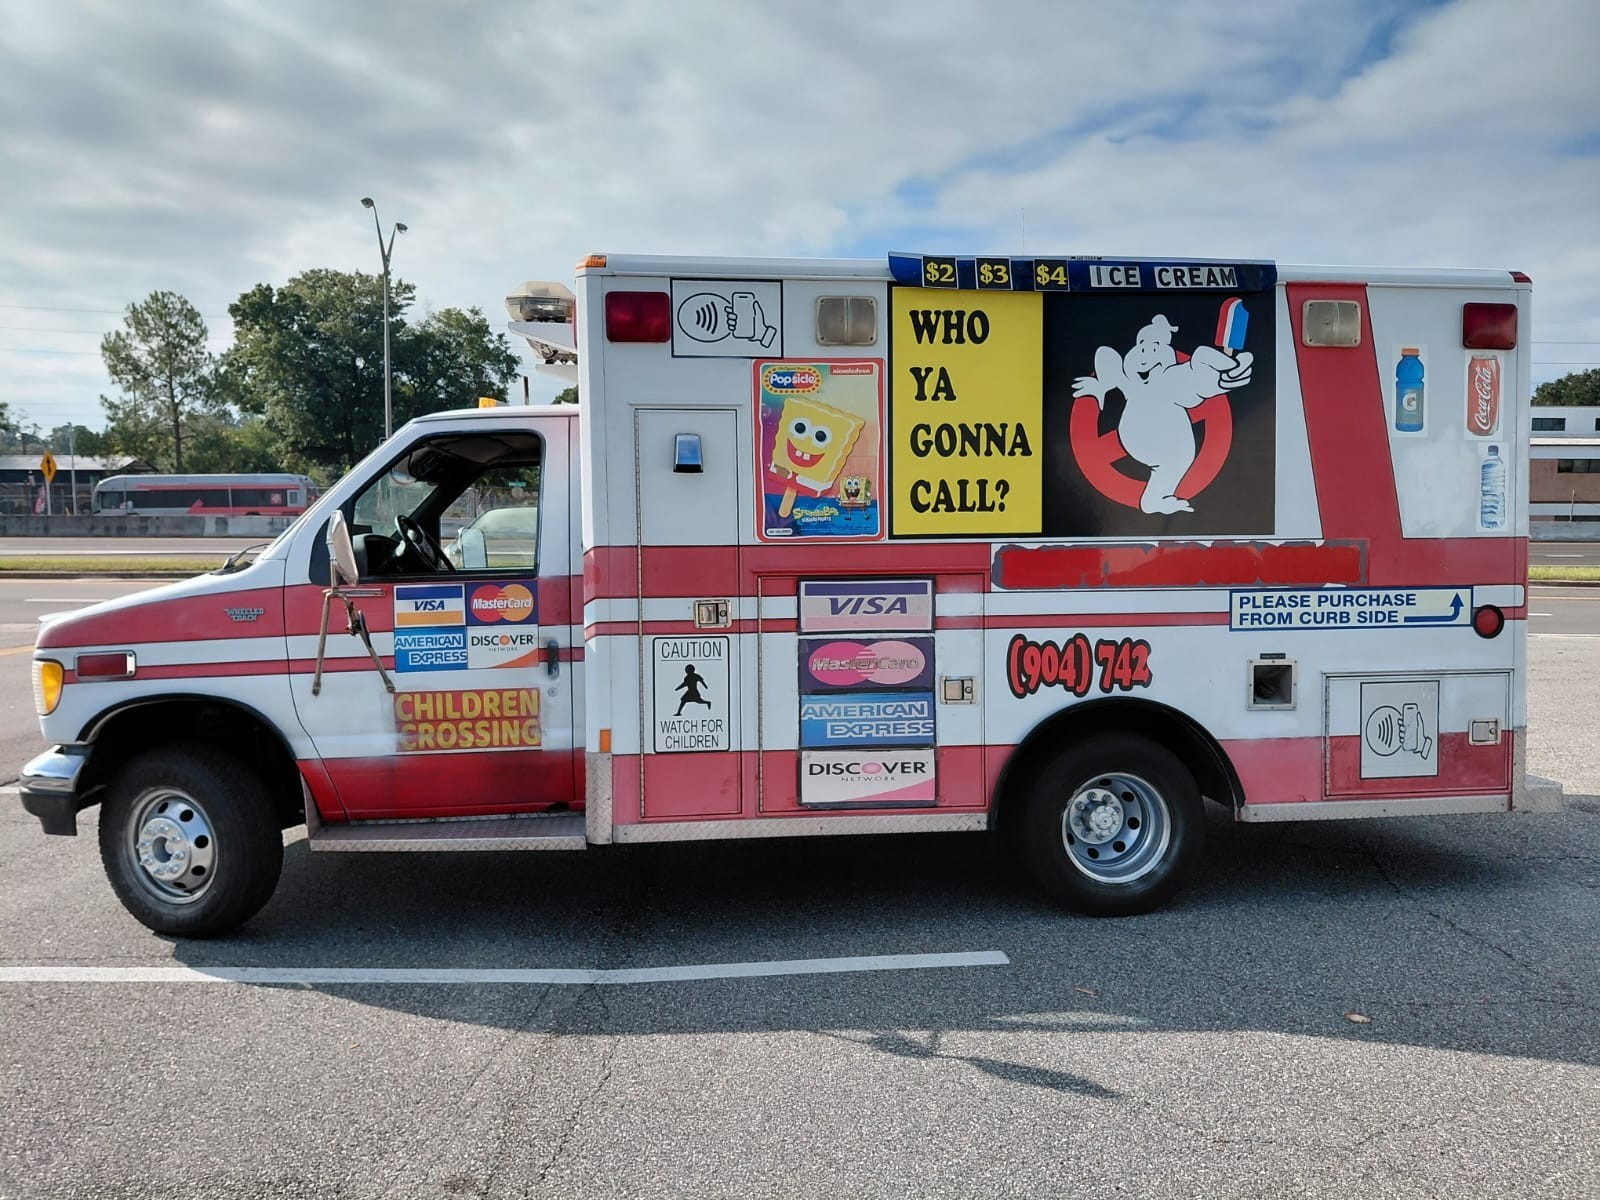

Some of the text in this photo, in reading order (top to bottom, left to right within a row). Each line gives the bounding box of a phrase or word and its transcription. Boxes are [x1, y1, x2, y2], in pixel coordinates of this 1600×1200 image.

[926, 261, 955, 283] $2
[980, 263, 1009, 284] $3
[1036, 264, 1067, 286] $4
[1095, 266, 1237, 287] ICE CREAM
[910, 310, 989, 344] WHO
[769, 373, 816, 386] Popsicle
[910, 366, 956, 401] YA
[910, 423, 1032, 457] GONNA
[910, 479, 1010, 513] CALL?
[414, 600, 445, 611] VISA
[472, 598, 533, 610] MasterCard
[828, 597, 908, 615] VISA
[1239, 593, 1417, 609] PLEASE PURCHASE
[1239, 610, 1399, 625] FROM CURB SIDE
[395, 634, 463, 649] AMERICAN
[471, 634, 534, 646] DISCOVER
[409, 650, 467, 665] EXPRESS
[661, 640, 722, 659] CAUTION
[811, 656, 920, 671] MasterCard
[395, 690, 539, 721] CHILDREN
[801, 701, 928, 720] AMERICAN
[401, 719, 541, 750] CROSSING
[660, 719, 723, 734] WATCH FOR
[827, 720, 934, 739] EXPRESS
[665, 735, 719, 749] CHILDREN
[808, 761, 926, 776] DISCOVER
